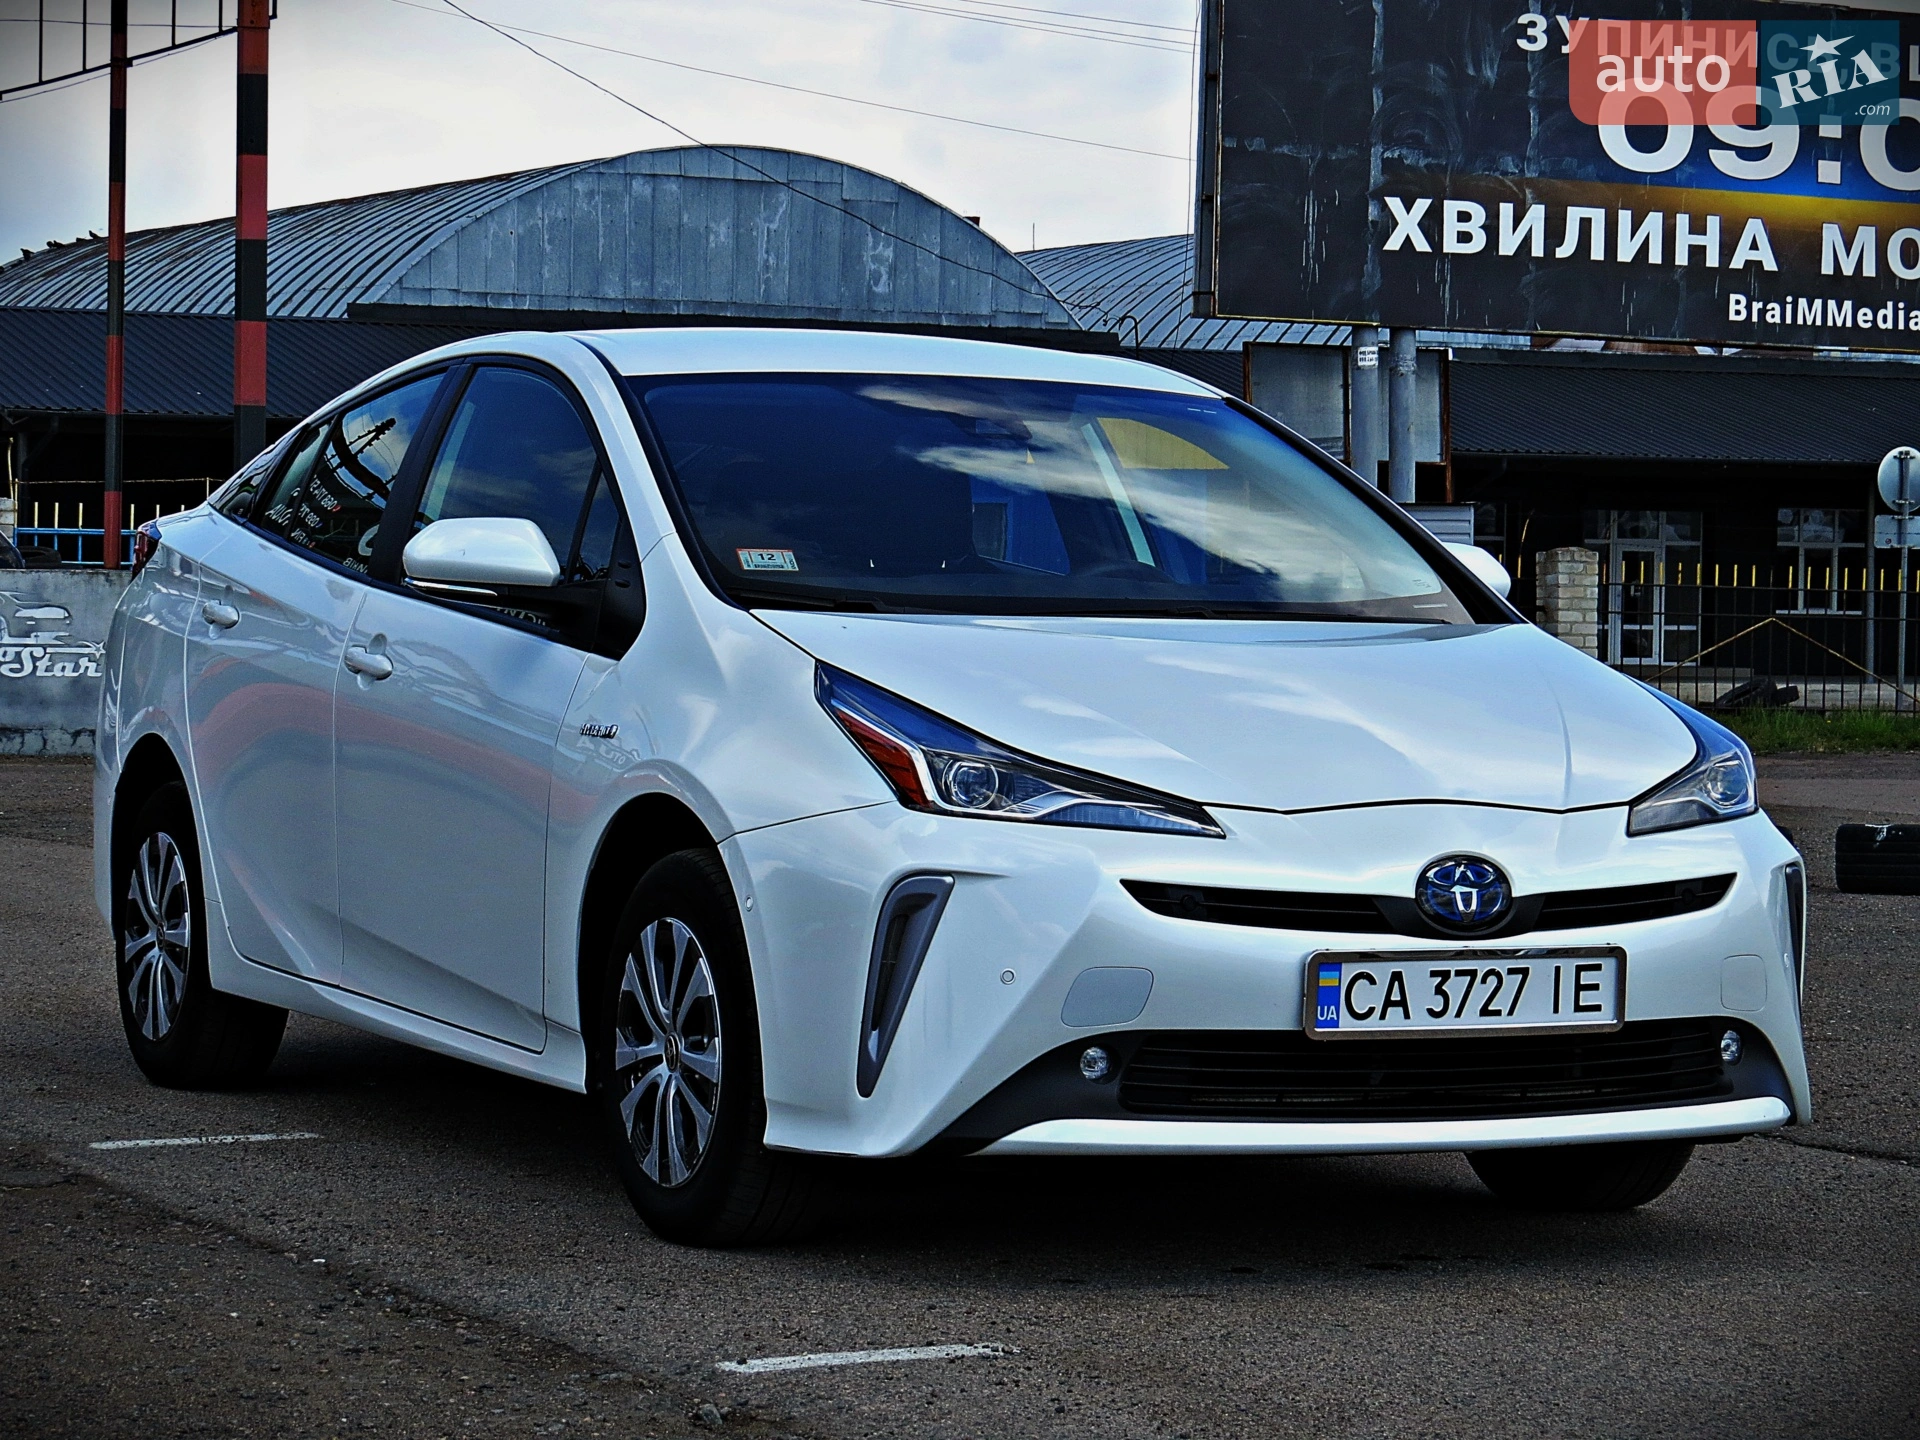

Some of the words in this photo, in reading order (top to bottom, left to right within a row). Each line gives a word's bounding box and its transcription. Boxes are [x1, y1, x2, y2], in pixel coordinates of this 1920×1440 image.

[1383, 196, 1778, 272] ХВИЛИНА
[757, 553, 777, 561] 12
[1344, 970, 1411, 1022] CA
[1425, 966, 1531, 1019] 3727
[1553, 963, 1604, 1015] IE
[1317, 1006, 1337, 1021] UA
